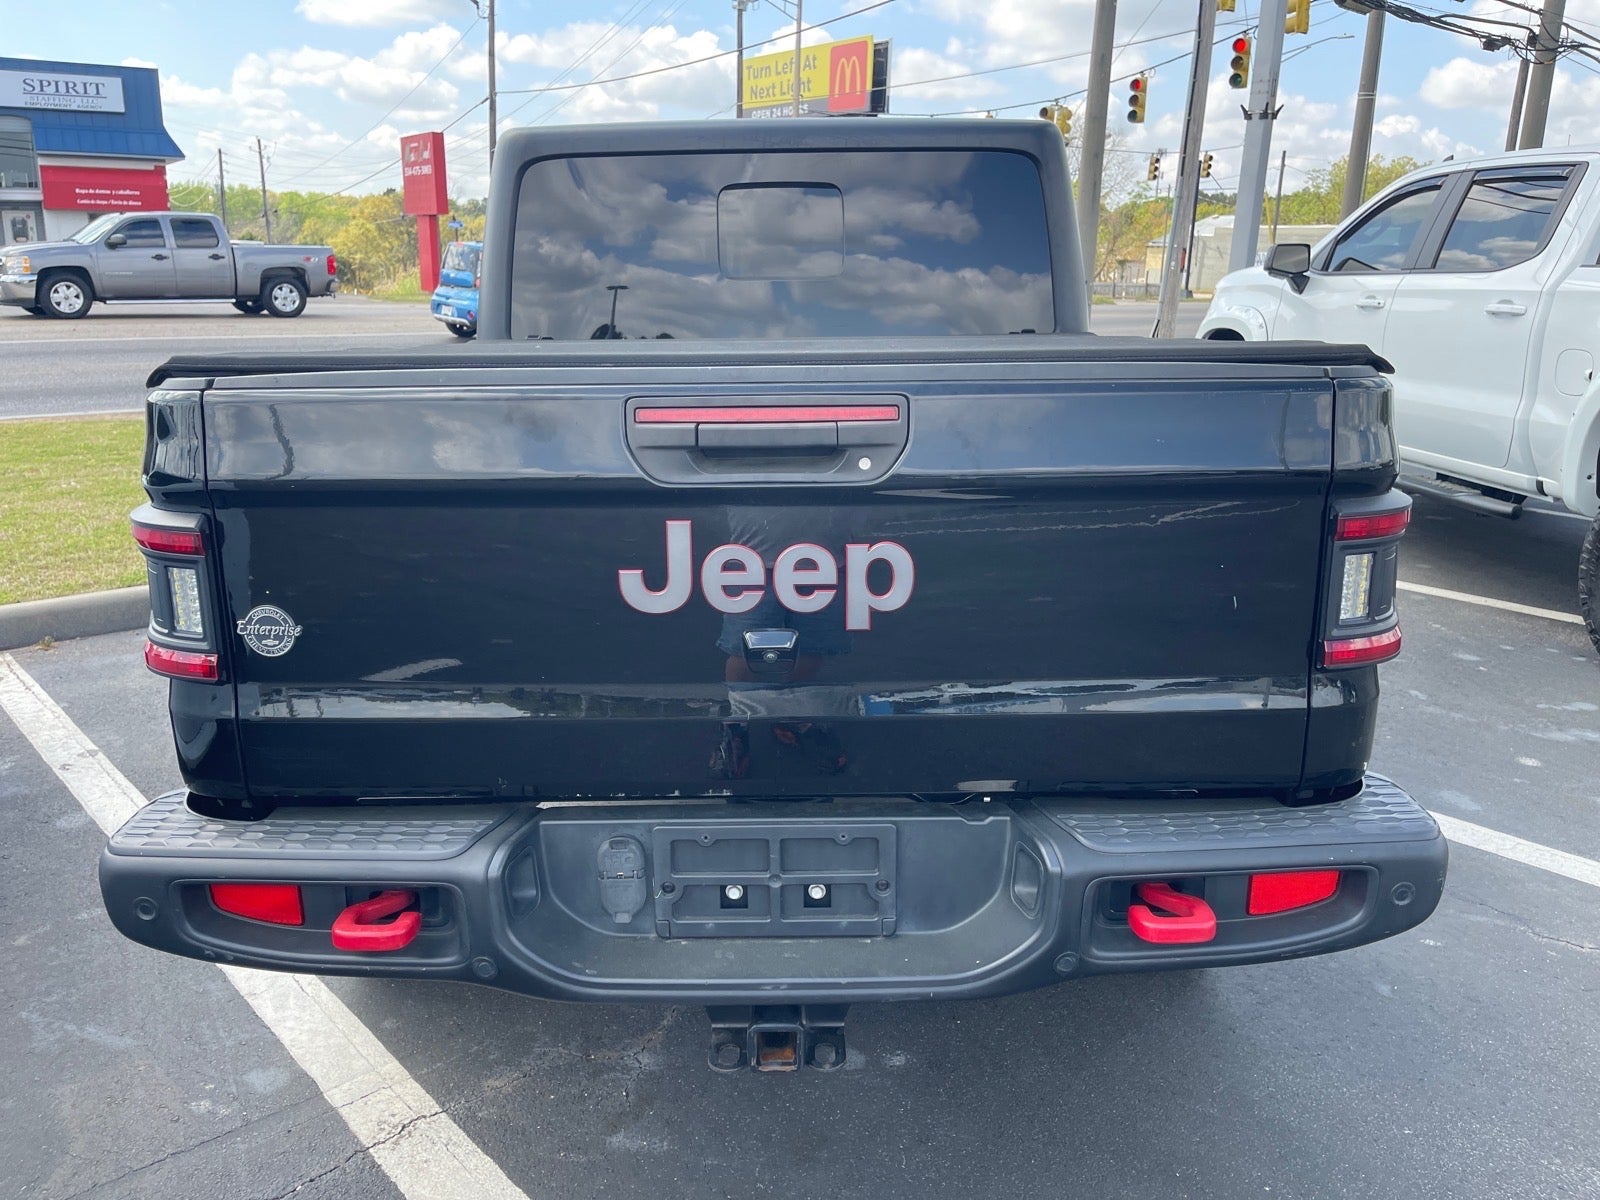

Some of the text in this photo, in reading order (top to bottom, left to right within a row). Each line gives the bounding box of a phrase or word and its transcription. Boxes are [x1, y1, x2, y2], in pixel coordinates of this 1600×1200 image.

[746, 54, 818, 80] Turn Lef At
[22, 77, 105, 96] SPIRIT
[750, 82, 776, 100] Next
[751, 109, 771, 119] OPEN
[772, 107, 782, 118] 24
[618, 518, 915, 631] Jeep
[236, 620, 303, 639] Enterprise
